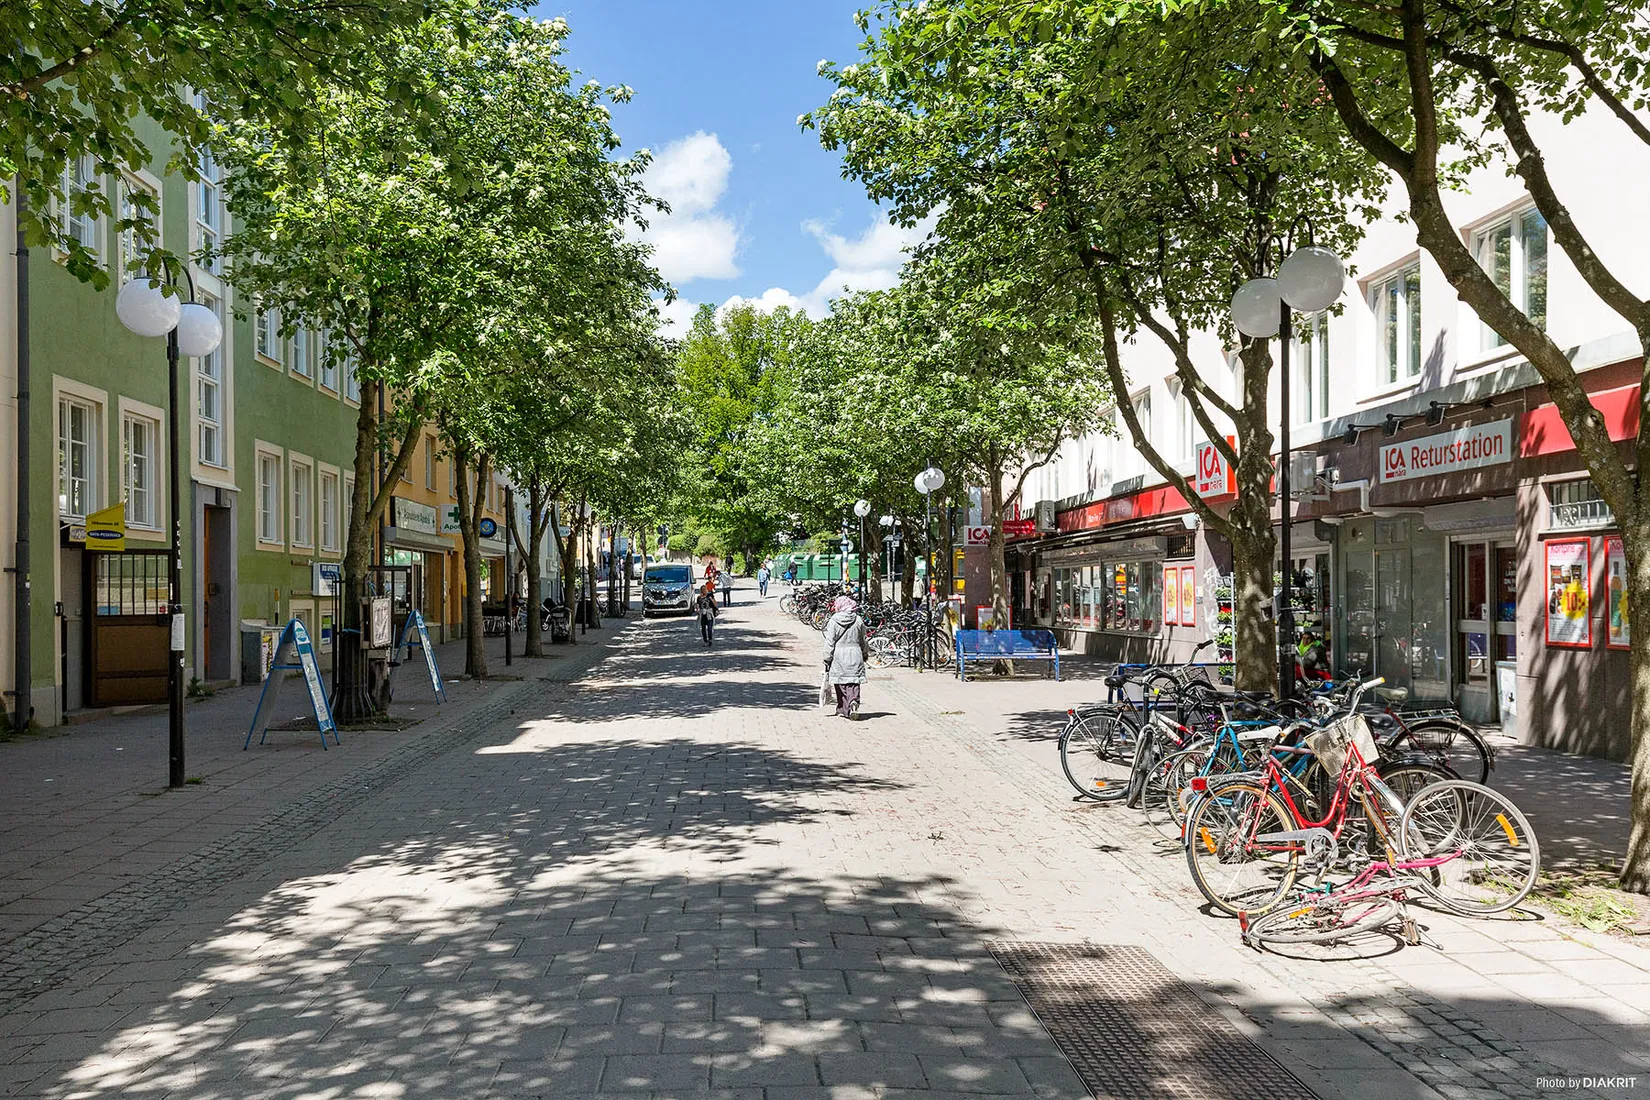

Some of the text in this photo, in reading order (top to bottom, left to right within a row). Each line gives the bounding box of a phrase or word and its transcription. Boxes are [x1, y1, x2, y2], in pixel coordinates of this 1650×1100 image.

[1199, 446, 1222, 480] ICA
[1386, 433, 1503, 471] ICA Returstation
[968, 528, 991, 540] ICA
